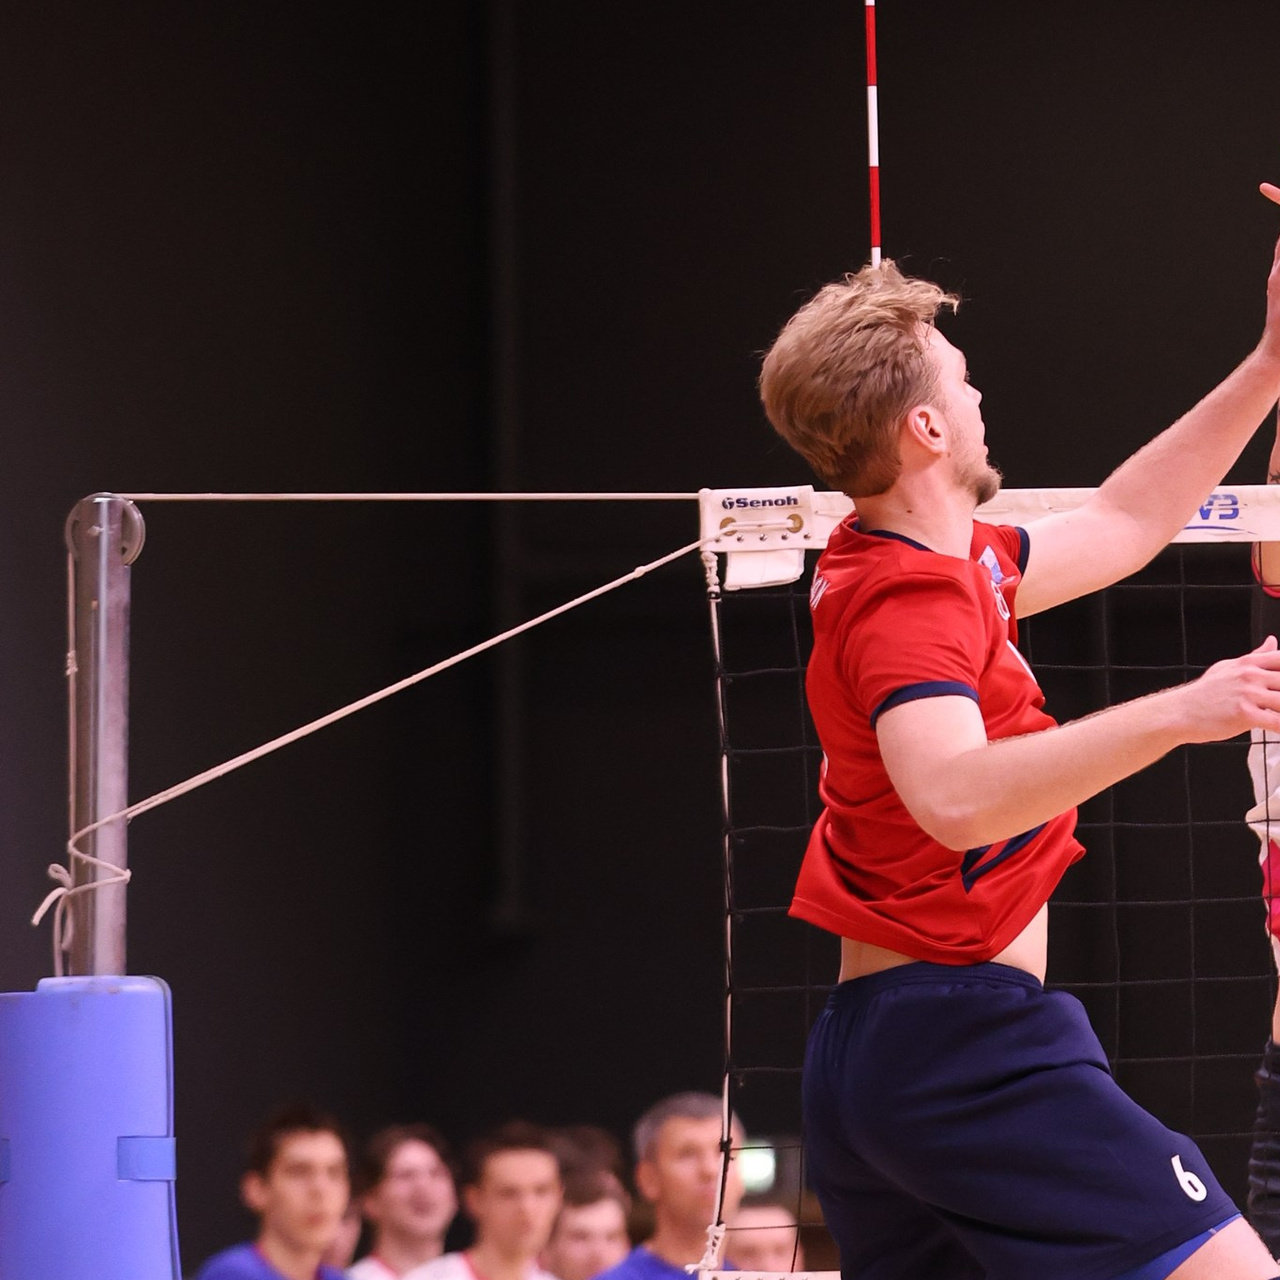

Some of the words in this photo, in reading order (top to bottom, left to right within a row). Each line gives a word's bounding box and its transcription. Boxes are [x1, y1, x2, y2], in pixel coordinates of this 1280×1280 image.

[735, 496, 799, 508] Senoh
[1199, 494, 1239, 520] VB
[1171, 1154, 1207, 1201] 6
